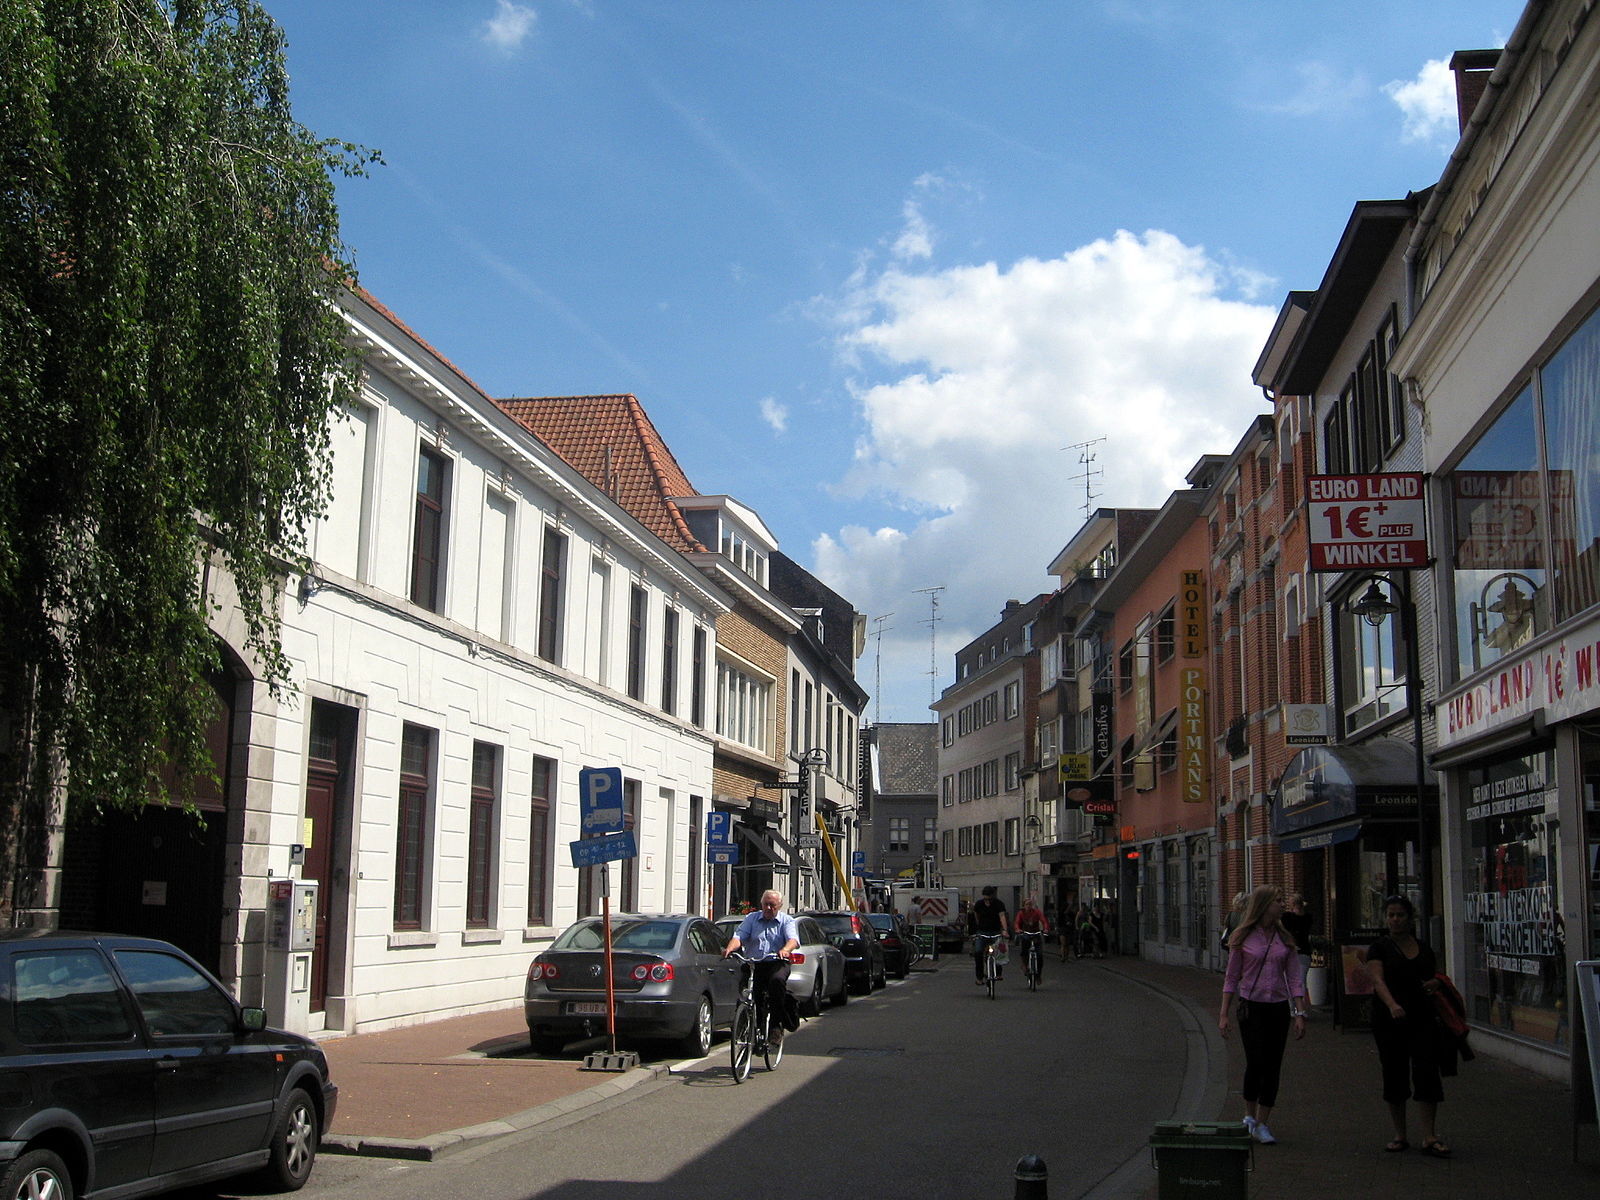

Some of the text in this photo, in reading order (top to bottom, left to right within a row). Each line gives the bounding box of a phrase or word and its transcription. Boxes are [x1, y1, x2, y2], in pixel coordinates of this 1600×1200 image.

[1310, 477, 1418, 500] EURO LAND
[1380, 525, 1412, 536] PLUS
[1324, 543, 1413, 565] WINKEL
[1184, 572, 1200, 655] HOTEL
[1448, 687, 1482, 734] EURO
[1490, 659, 1533, 715] LAND
[1186, 670, 1203, 800] PORTMANS
[1290, 736, 1324, 744] Leonidas
[589, 773, 611, 807] P
[1375, 794, 1417, 804] Leonida
[712, 814, 723, 830] P
[291, 844, 303, 859] P
[855, 852, 862, 862] P
